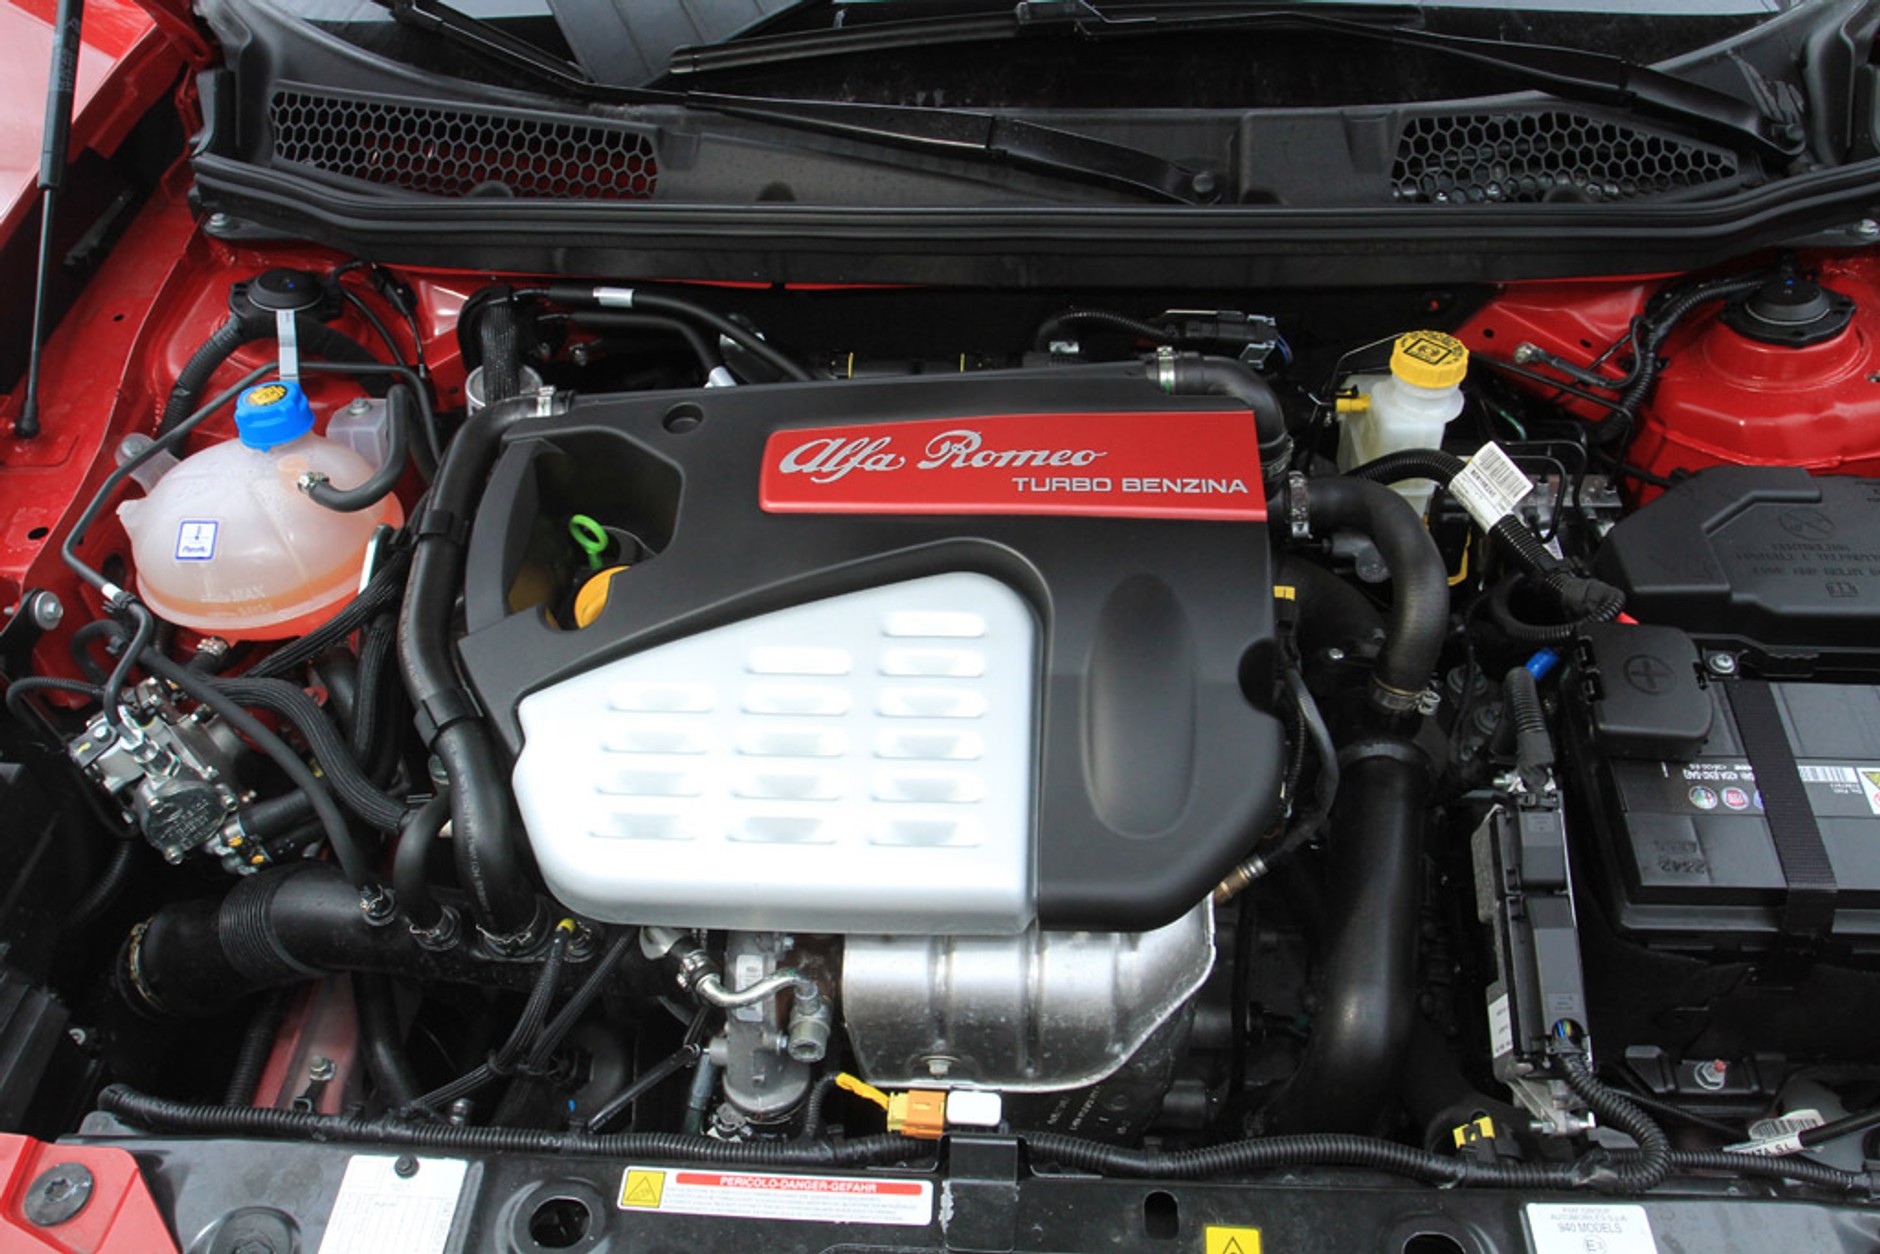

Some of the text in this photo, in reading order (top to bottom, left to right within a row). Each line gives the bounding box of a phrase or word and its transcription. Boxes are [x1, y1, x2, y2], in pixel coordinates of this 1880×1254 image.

[779, 430, 1107, 483] Alfa Romeo
[1012, 476, 1248, 494] TURBO BENZINA
[720, 1176, 877, 1193] PERICOLO-DANGER-GEFAHR
[1557, 1222, 1622, 1233] 940 MODELS
